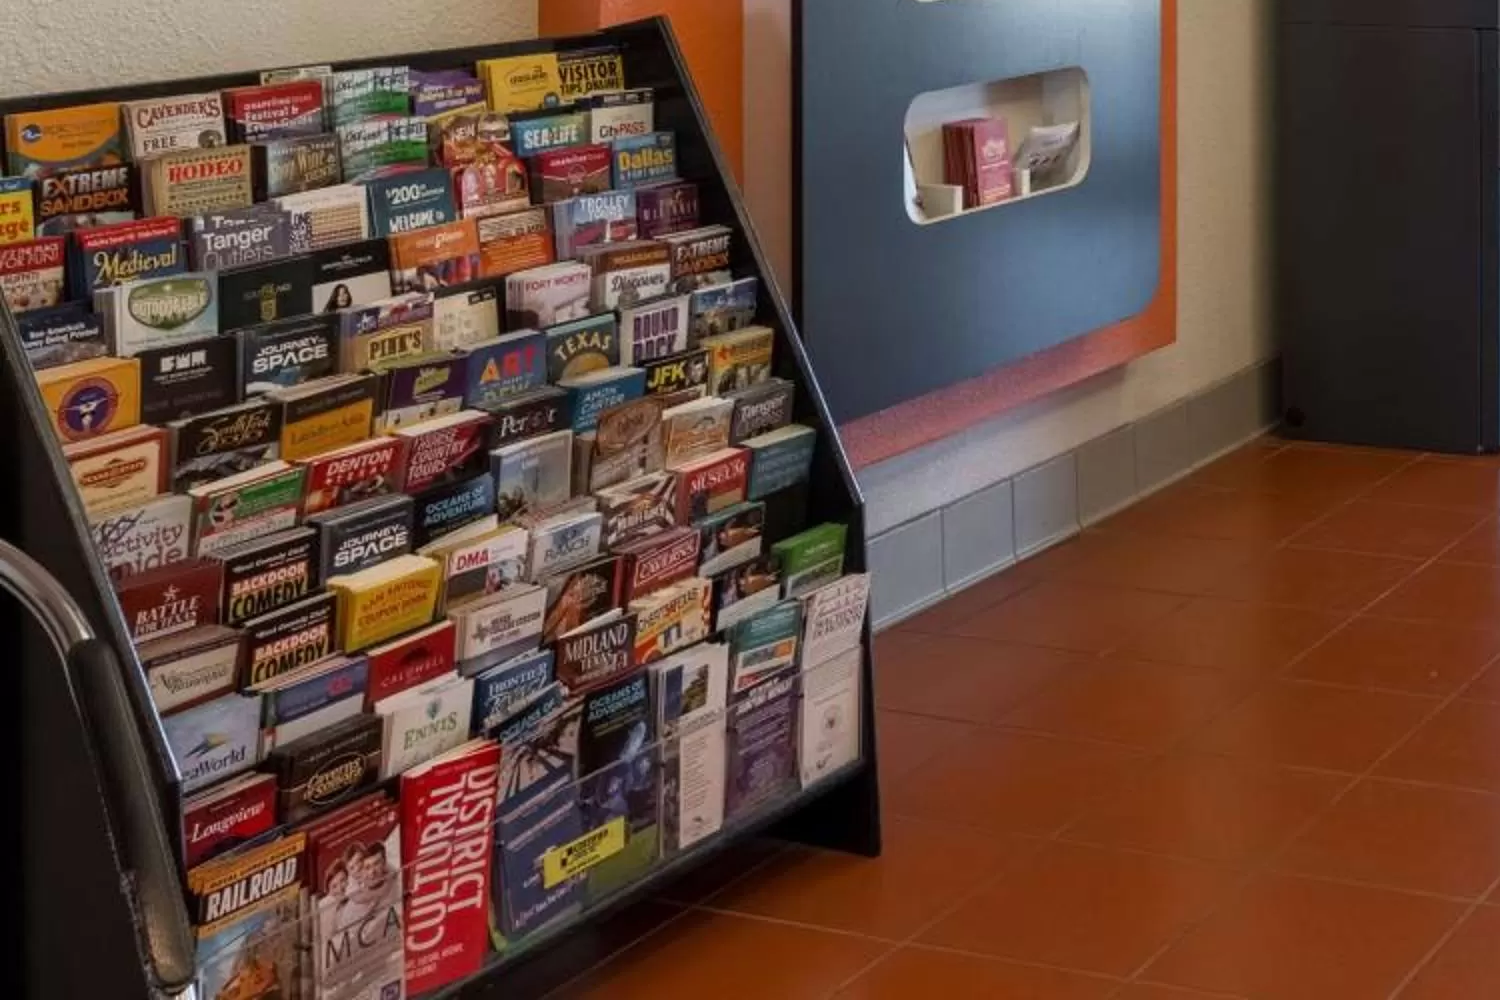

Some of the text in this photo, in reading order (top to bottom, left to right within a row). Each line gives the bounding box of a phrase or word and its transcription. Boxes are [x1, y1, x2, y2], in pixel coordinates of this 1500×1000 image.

[559, 60, 617, 82] VISITOR
[137, 98, 220, 128] CAVENDER'S
[143, 136, 177, 151] FREE
[619, 147, 673, 170] Dallas
[43, 167, 129, 197] EXTREME
[168, 158, 243, 183] RODEO
[40, 188, 129, 216] SANDBOX
[580, 193, 631, 211] TROLLEY
[201, 226, 273, 251] Tanger
[93, 243, 177, 285] Medieval
[204, 245, 274, 272] Outlets
[525, 270, 589, 292] FORT WORTH
[252, 343, 329, 374] SPACE
[256, 334, 320, 358] JOURNEY
[555, 330, 613, 360] TEXAS
[648, 360, 687, 388] JFK
[326, 448, 393, 476] DENTON
[335, 532, 409, 568] SPACE
[340, 522, 399, 550] JOURNEY
[233, 561, 306, 595] BACKDOOR
[137, 595, 200, 625] BATTLE
[232, 577, 306, 619] COMEDY
[255, 624, 328, 661] BACKDOOR
[564, 623, 628, 664] MIDLAND
[254, 641, 328, 686] COMEDY
[403, 711, 457, 751] ENNIS
[183, 745, 247, 782] eaWorld
[192, 801, 265, 843] Longview
[448, 764, 498, 913] DISTRICT
[406, 773, 467, 952] CULTURAL
[207, 857, 297, 922] RAILROAD
